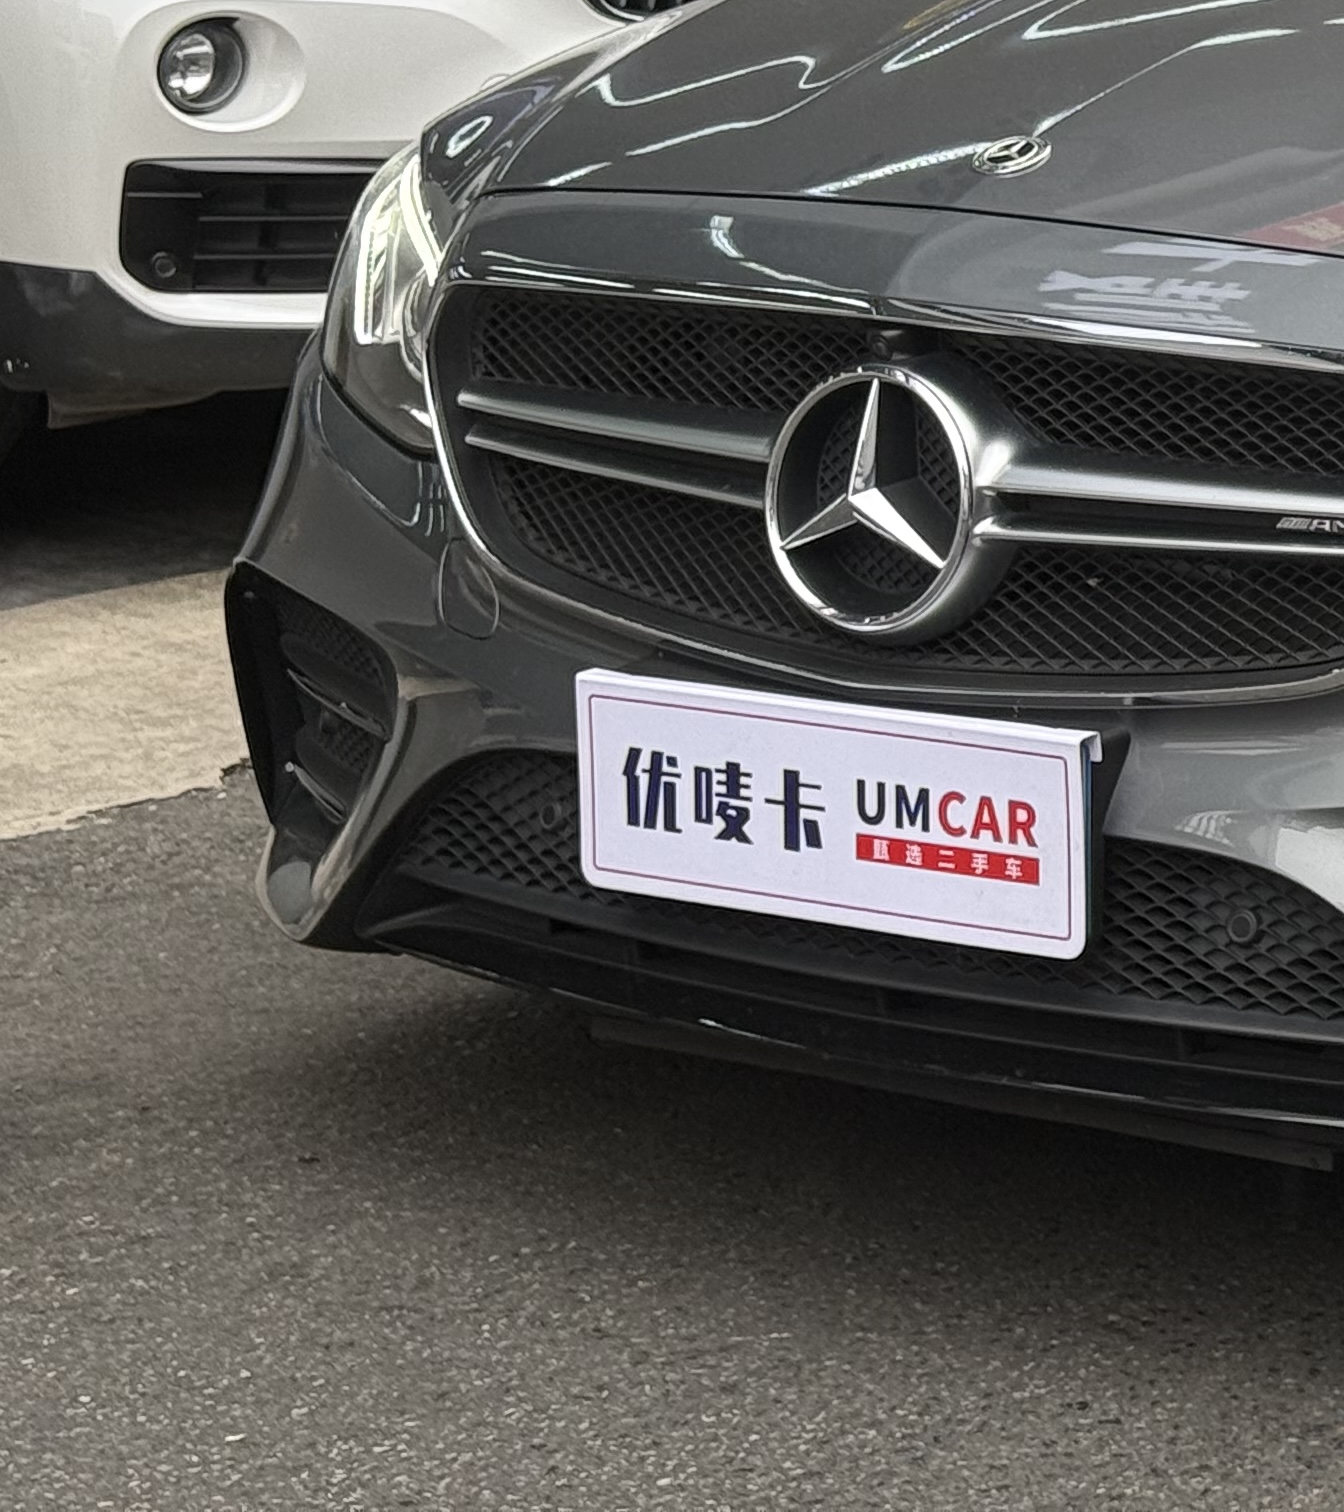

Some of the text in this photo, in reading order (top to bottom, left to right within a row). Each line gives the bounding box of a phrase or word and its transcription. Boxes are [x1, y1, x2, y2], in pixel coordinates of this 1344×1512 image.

[622, 745, 1039, 852] 优唛卡 UMCAR
